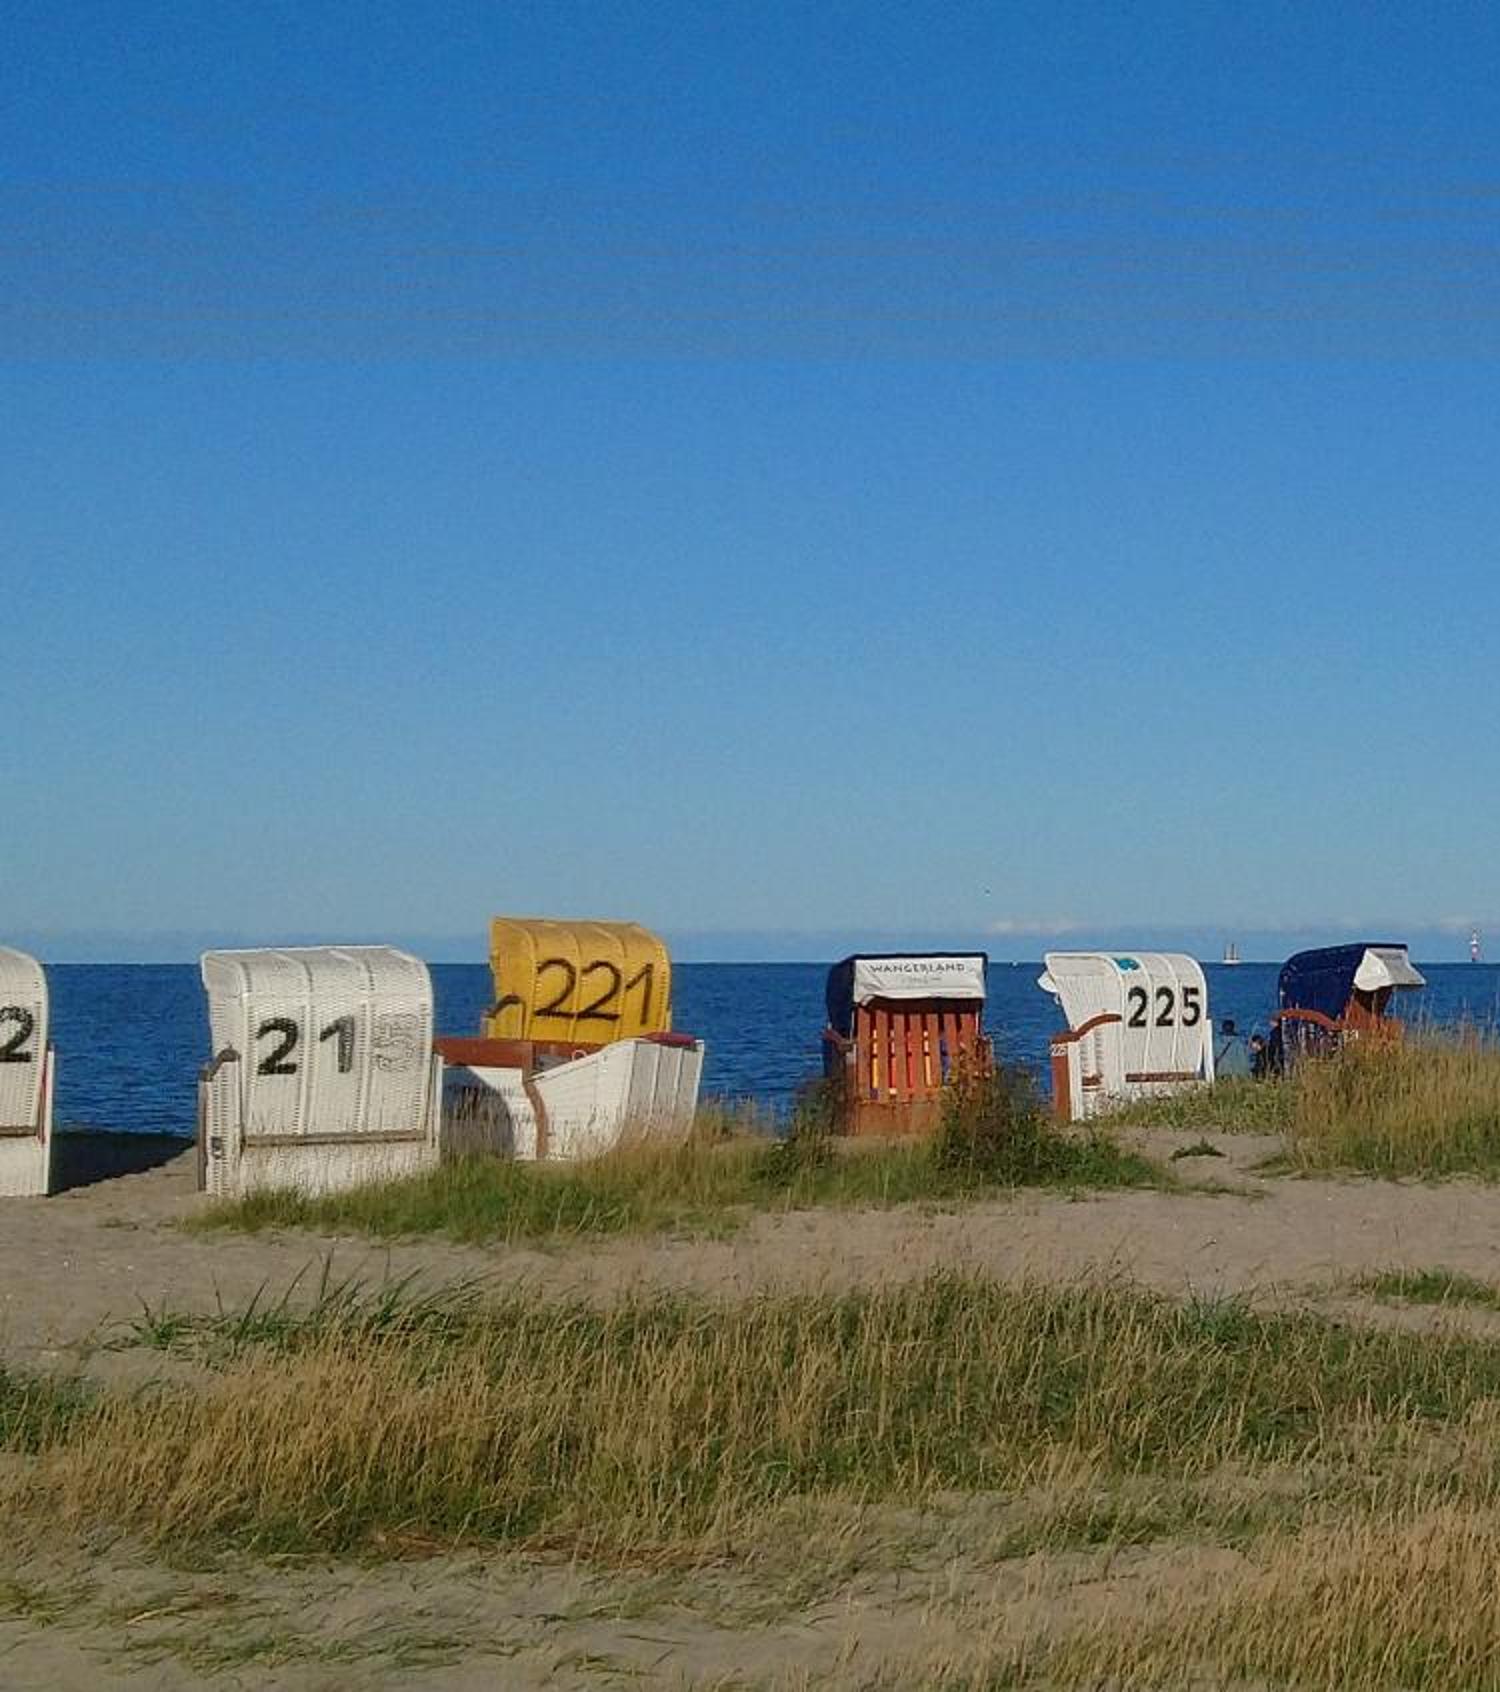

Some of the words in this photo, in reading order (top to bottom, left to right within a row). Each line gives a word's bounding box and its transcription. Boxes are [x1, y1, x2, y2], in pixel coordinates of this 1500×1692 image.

[870, 963, 965, 973] WANGERLAND
[534, 958, 653, 1025] 221
[1128, 986, 1200, 1028] 225
